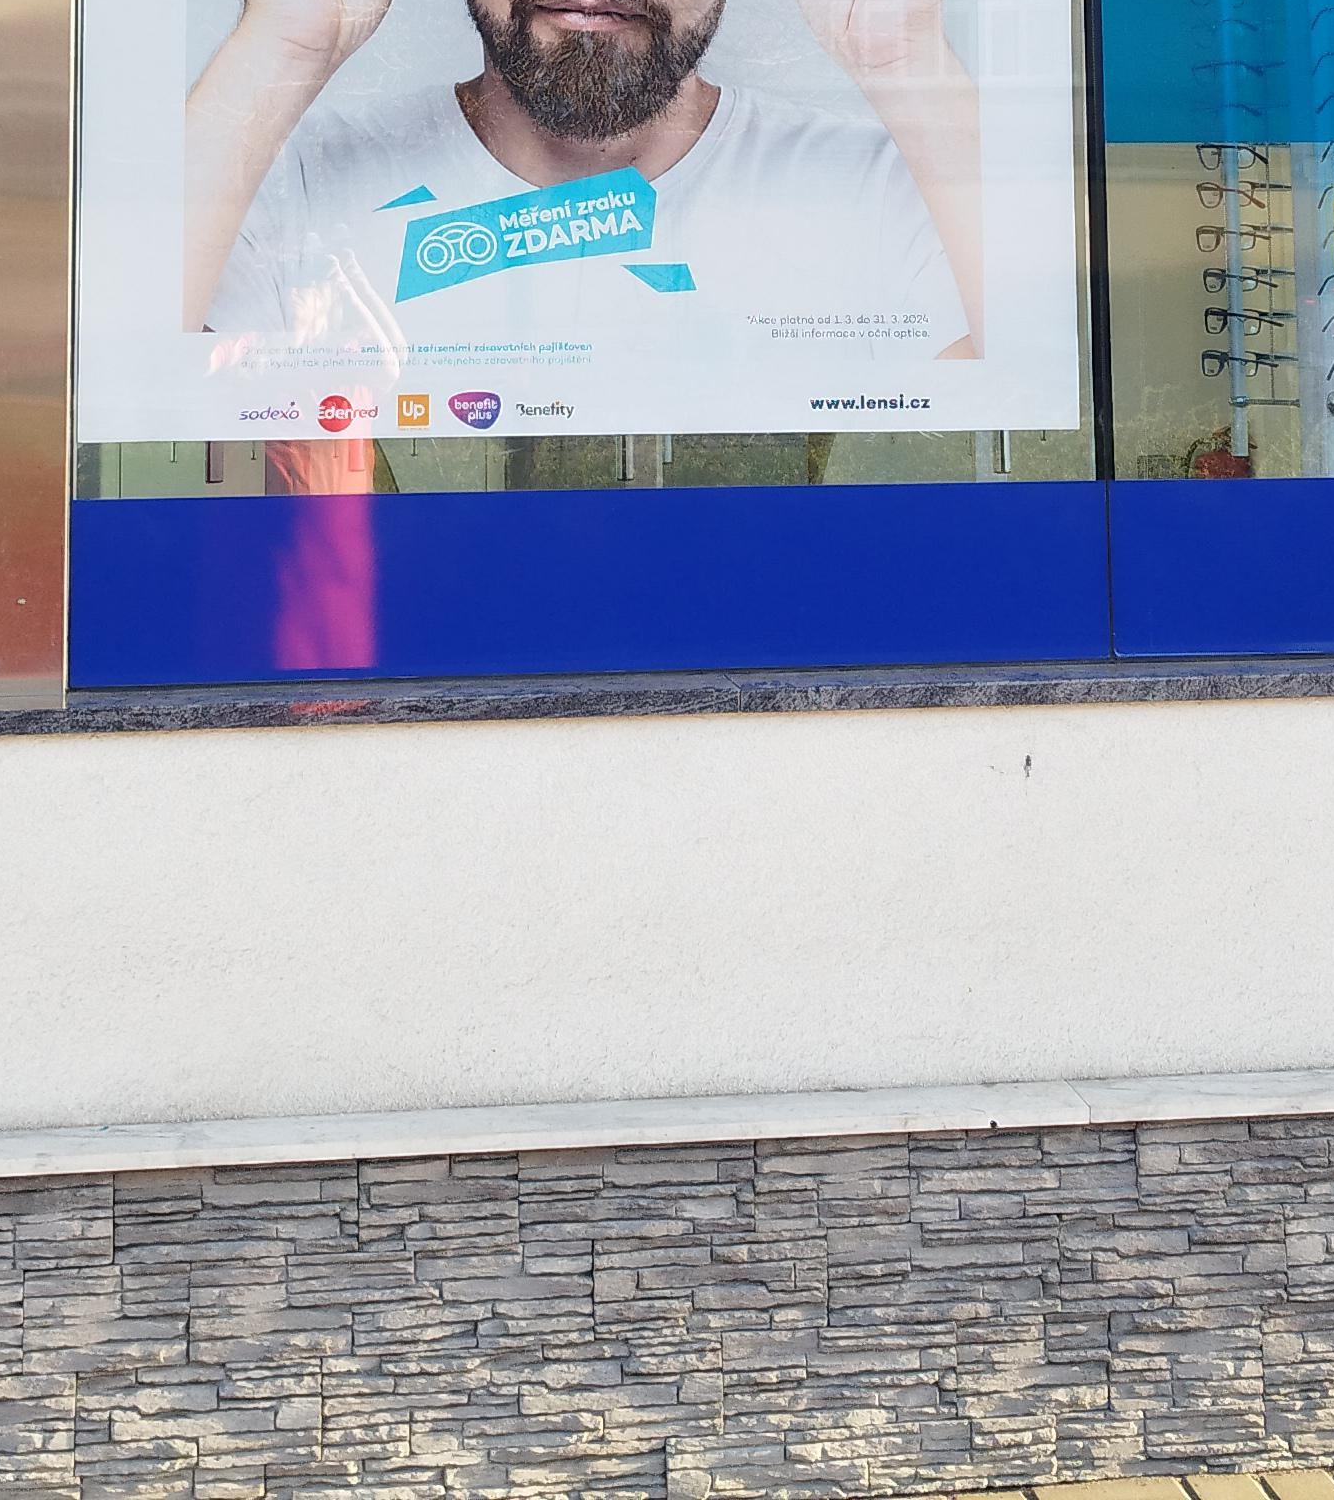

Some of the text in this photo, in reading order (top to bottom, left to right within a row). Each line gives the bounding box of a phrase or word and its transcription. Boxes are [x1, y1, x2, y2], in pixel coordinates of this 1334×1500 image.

[499, 190, 635, 231] Měření zraku
[503, 209, 643, 258] ZDARMA
[817, 314, 831, 325] od
[856, 314, 871, 325] do
[454, 398, 498, 411] benefit
[810, 393, 931, 409] www.lensi.cz
[238, 402, 300, 420] sodexo
[317, 404, 379, 420] Edenred
[402, 401, 424, 420] Up
[468, 409, 493, 424] plus
